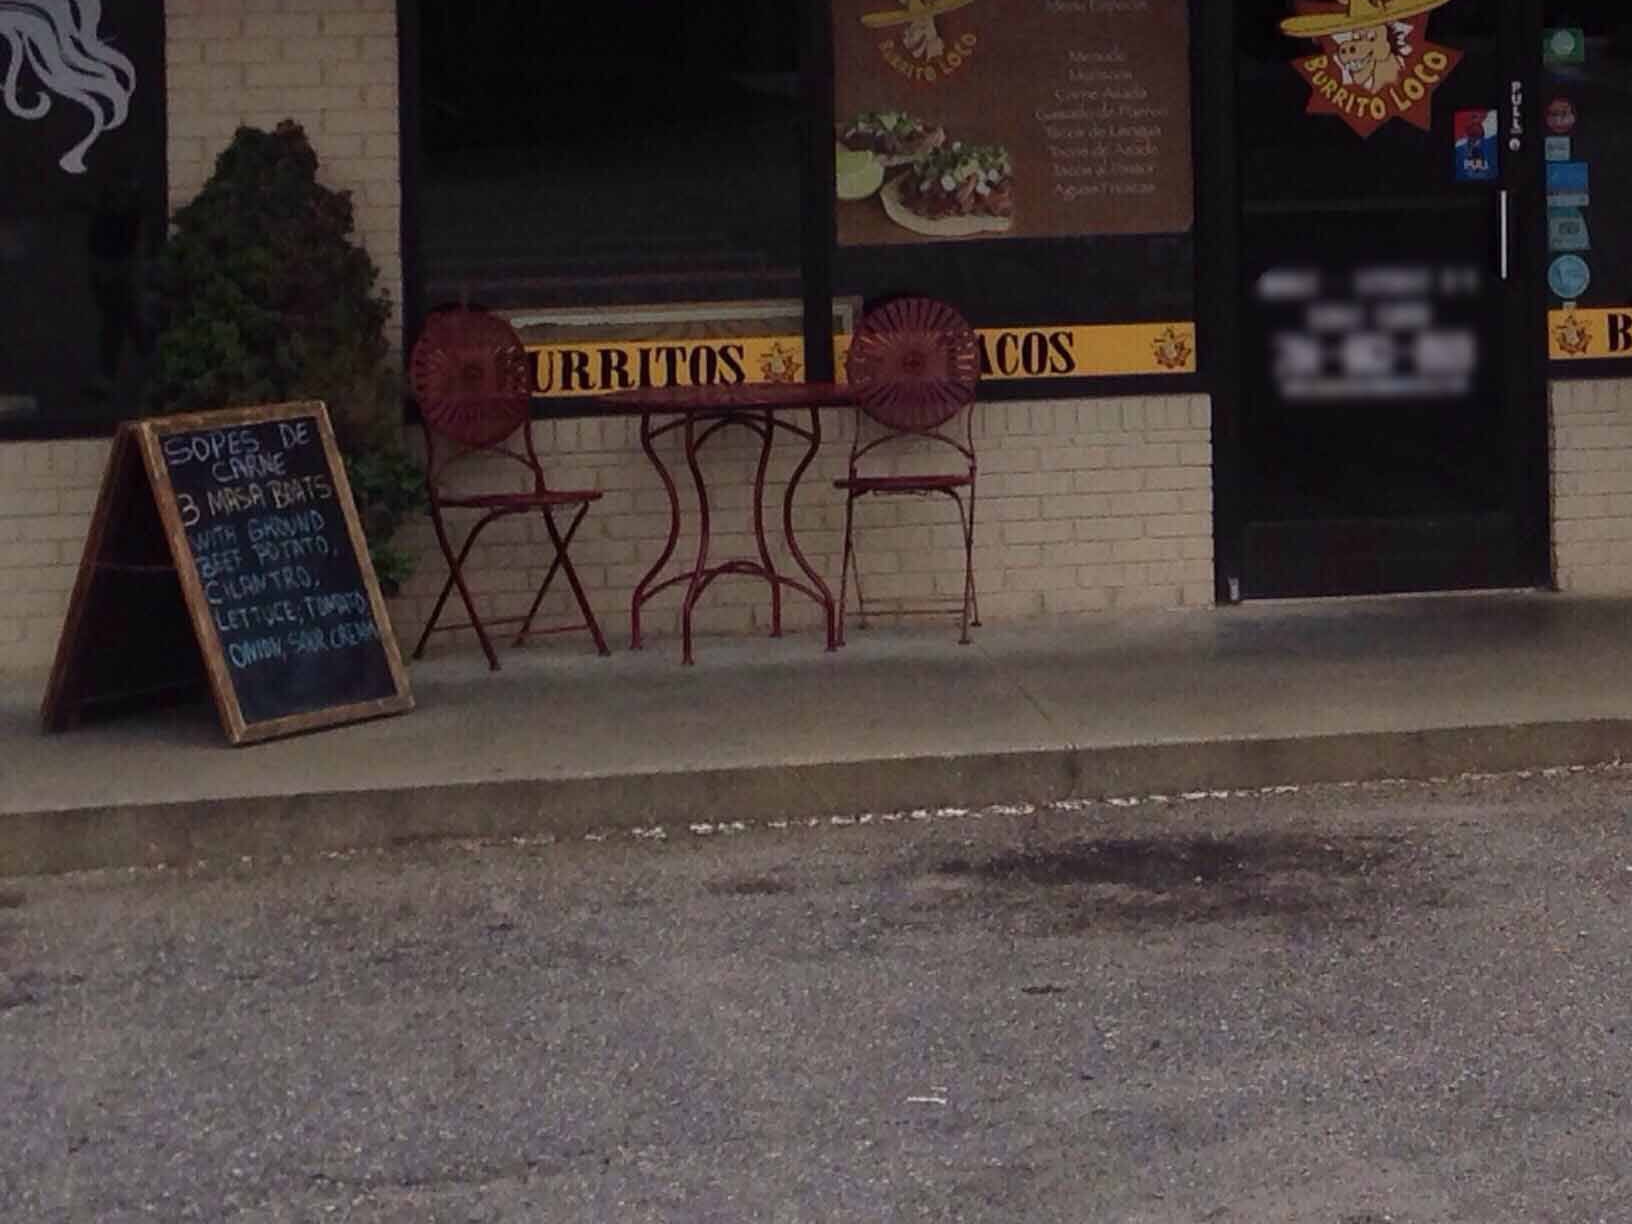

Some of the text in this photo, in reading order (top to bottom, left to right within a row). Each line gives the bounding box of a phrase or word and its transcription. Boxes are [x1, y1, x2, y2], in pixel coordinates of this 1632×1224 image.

[1303, 50, 1448, 121] BURRITO LOCO
[1510, 80, 1523, 129] PULL
[529, 344, 745, 393] URRITOS
[163, 422, 311, 465] SOPES DE
[211, 452, 287, 483] CARNE
[176, 493, 200, 527] 3
[207, 482, 266, 517] MASA
[247, 510, 326, 543] GROUND
